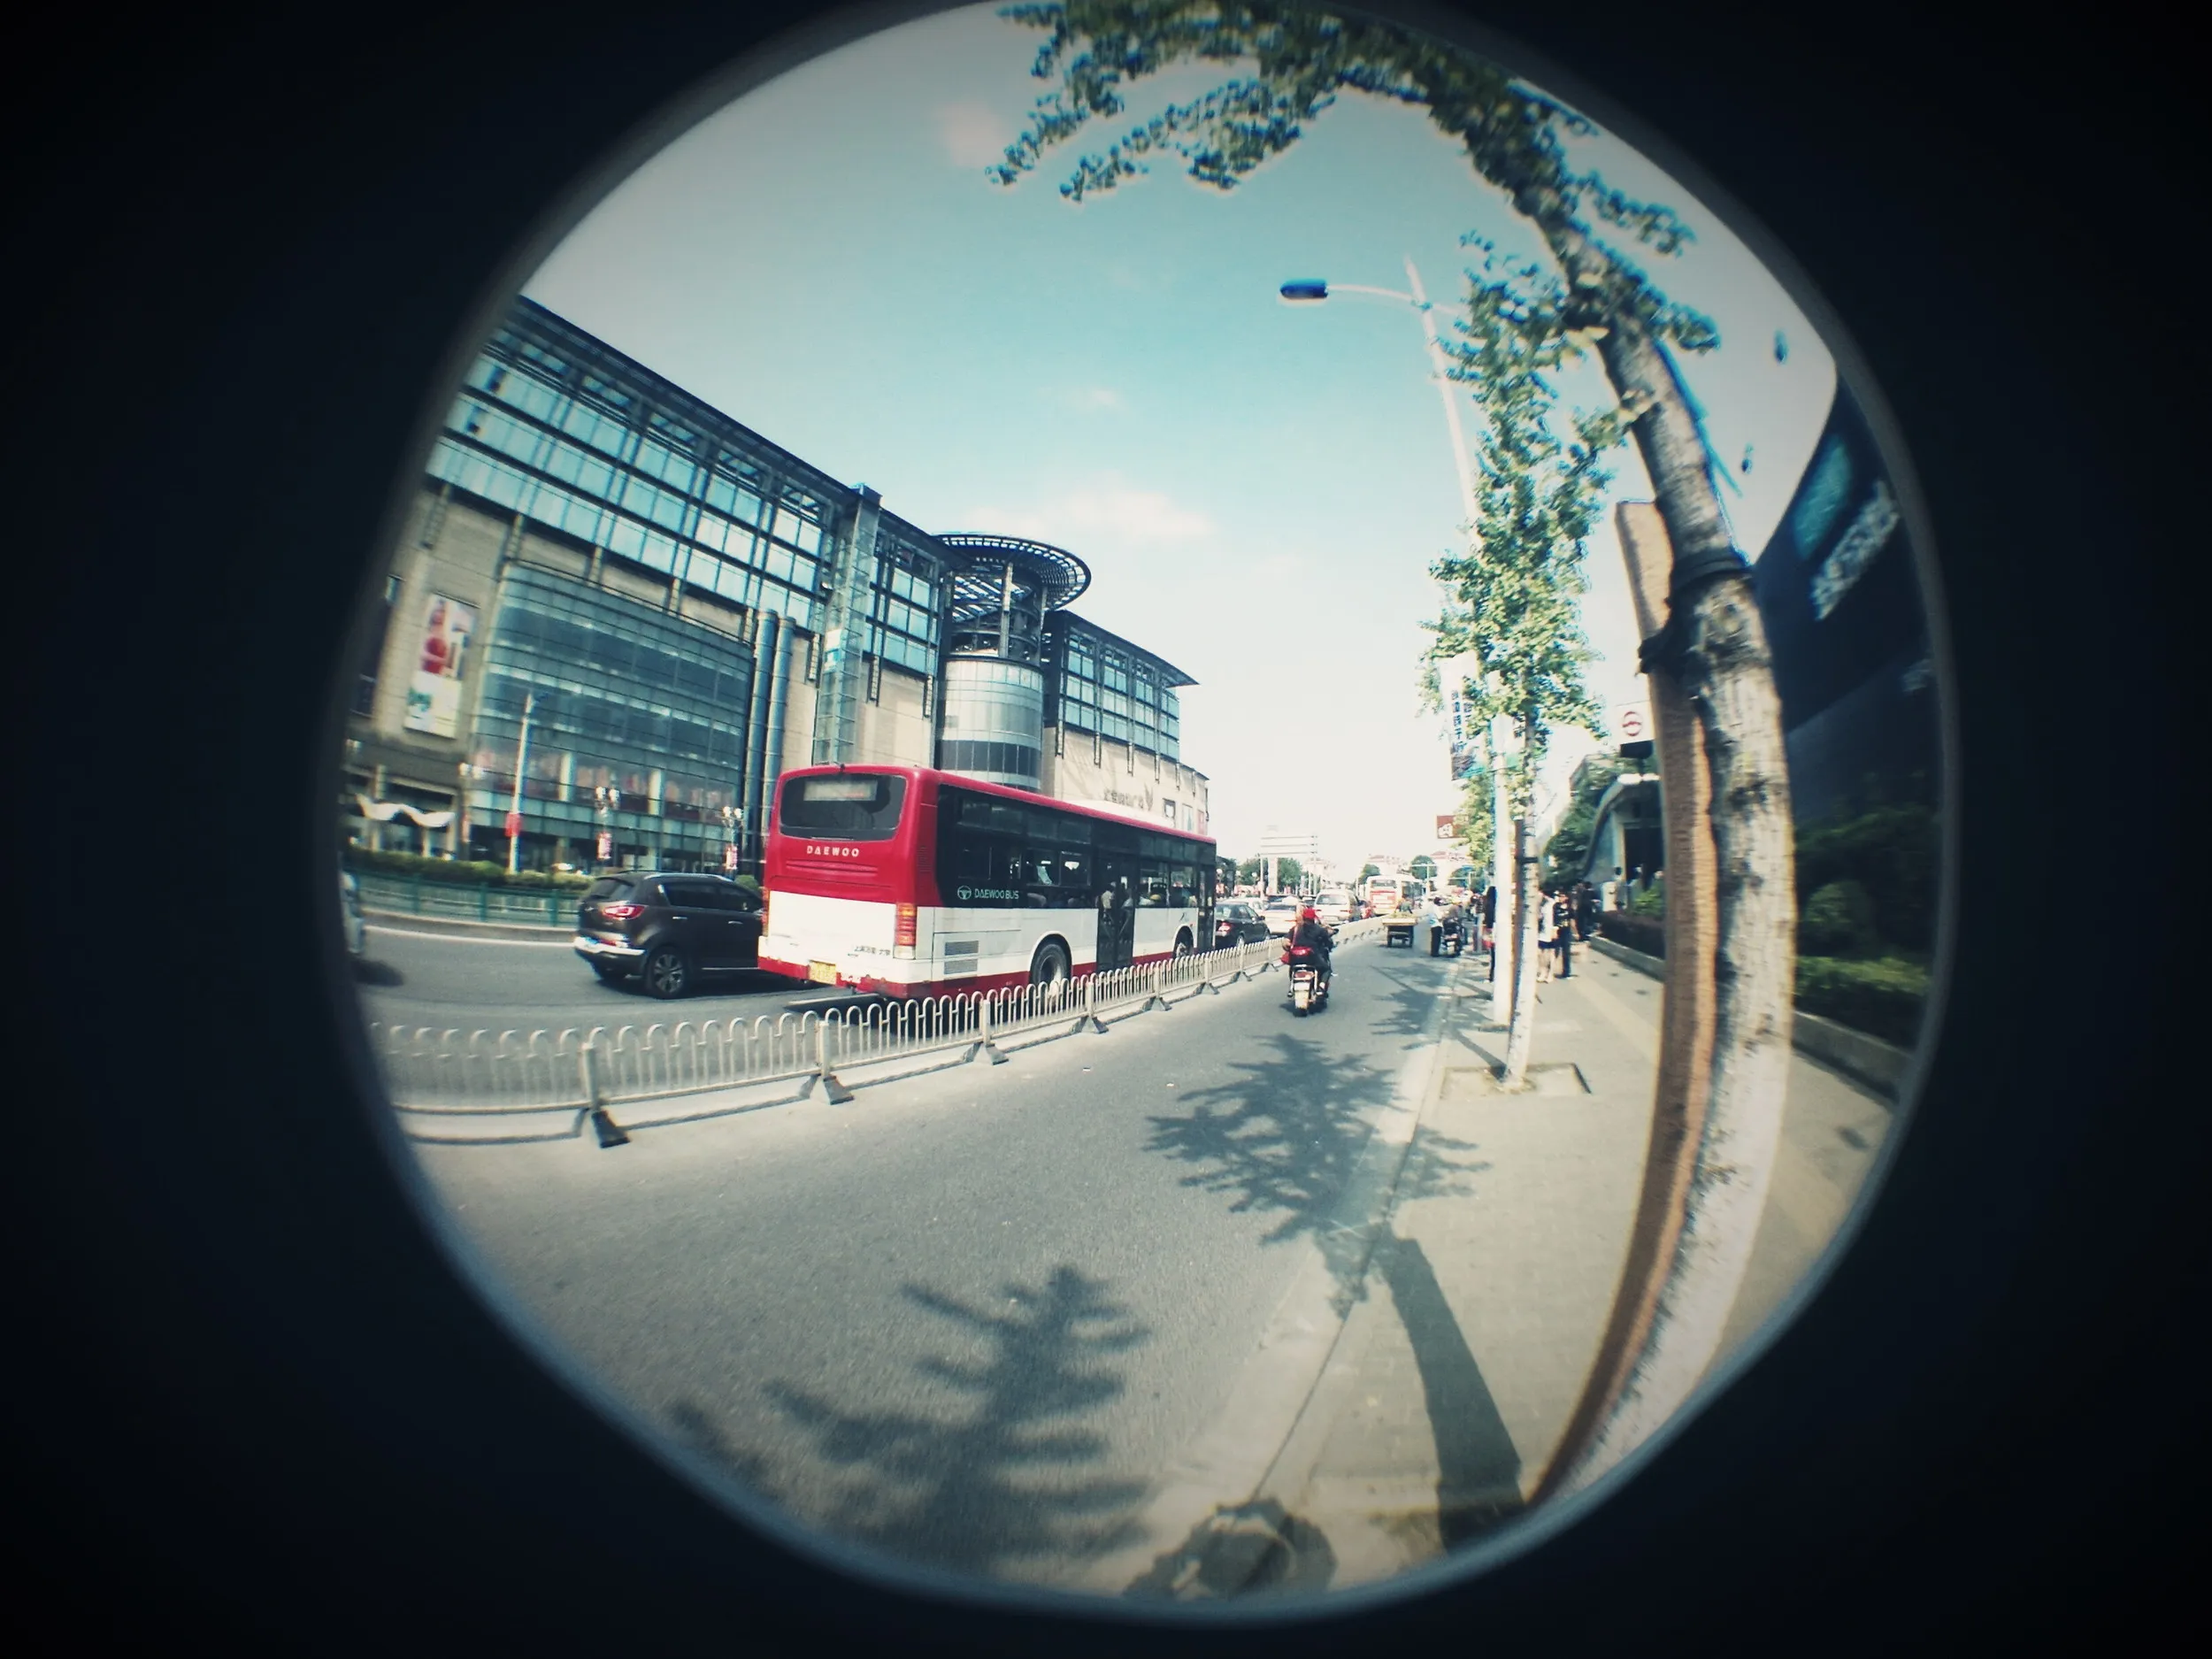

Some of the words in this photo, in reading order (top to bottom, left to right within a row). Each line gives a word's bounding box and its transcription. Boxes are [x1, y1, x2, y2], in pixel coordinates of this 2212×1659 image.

[806, 845, 860, 857] DAEWOO
[974, 887, 1005, 899] DAEWOO
[1005, 889, 1019, 900] BUS
